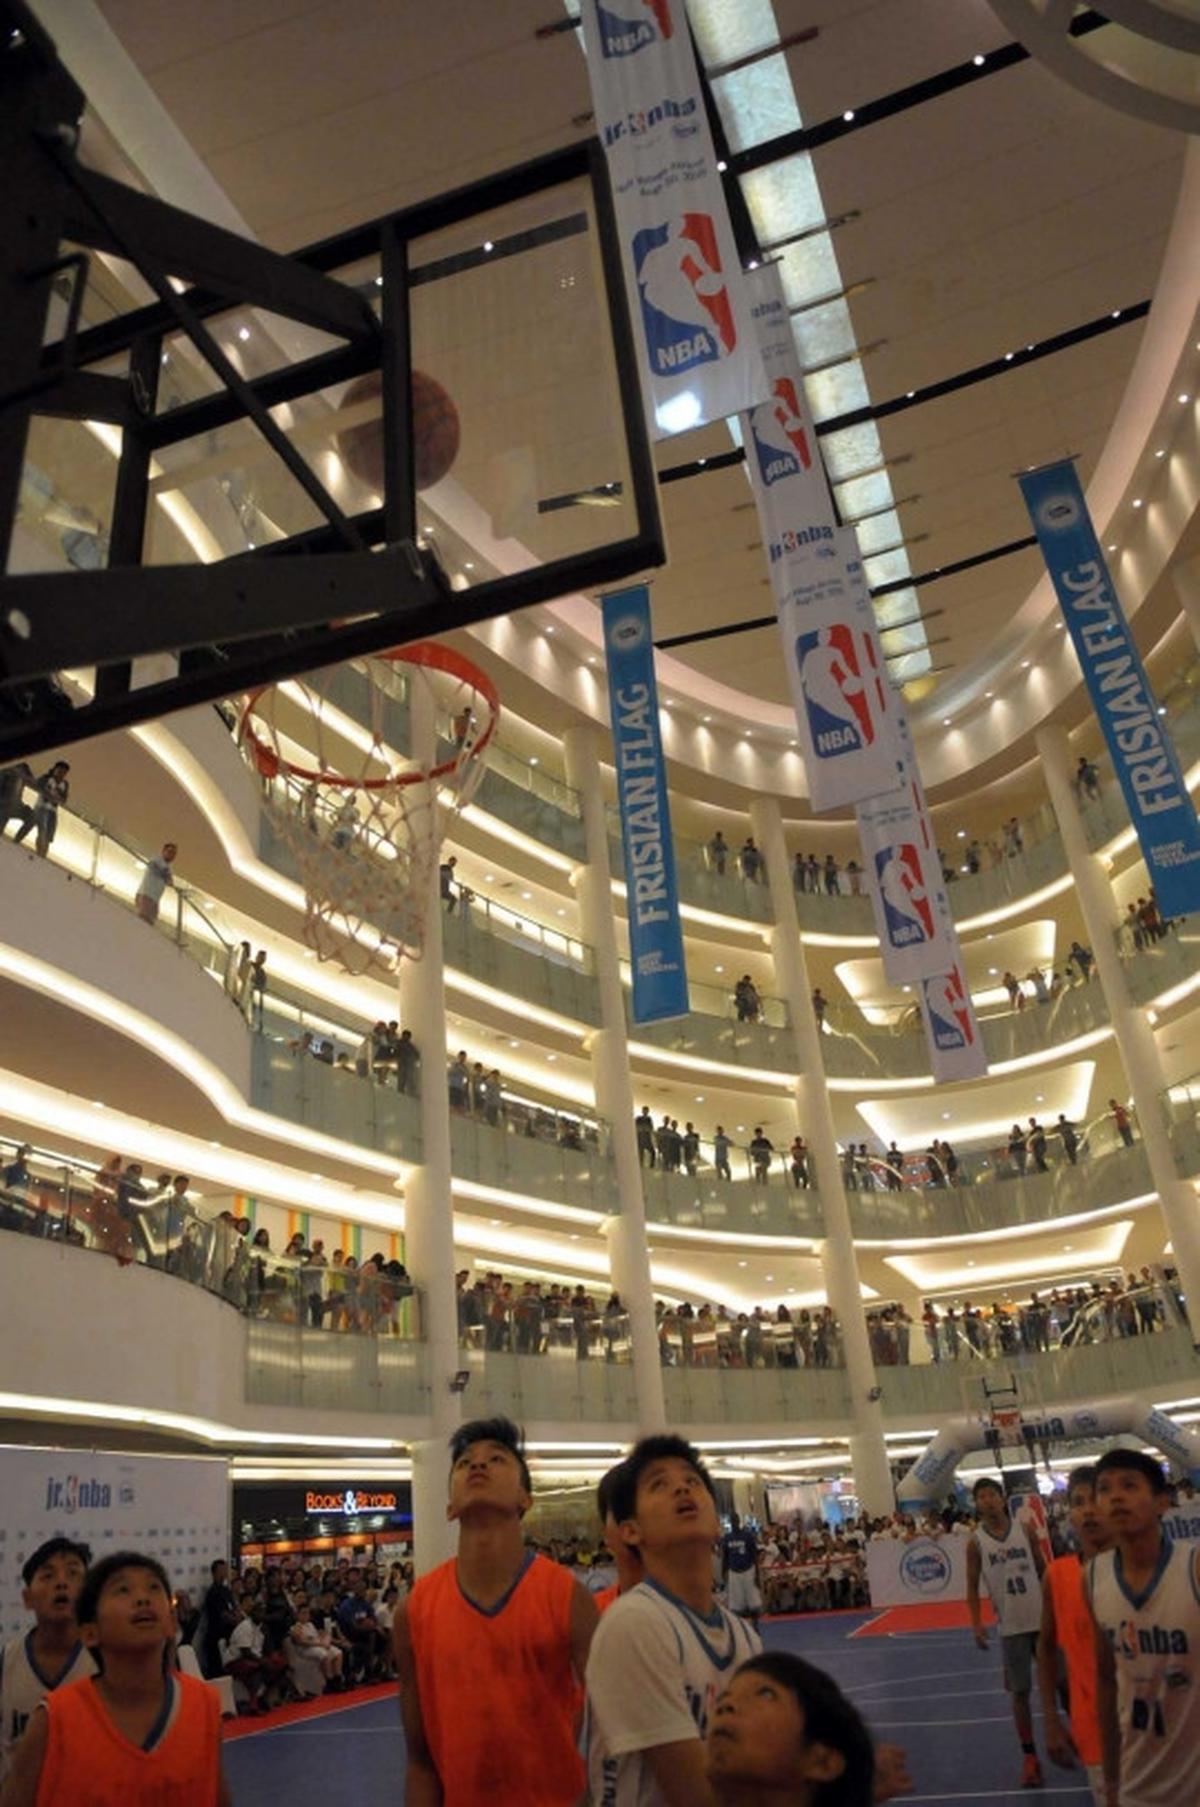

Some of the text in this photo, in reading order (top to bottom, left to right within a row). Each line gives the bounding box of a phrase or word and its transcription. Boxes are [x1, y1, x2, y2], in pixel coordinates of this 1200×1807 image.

[607, 24, 652, 54] NBA
[657, 332, 712, 369] NBA
[1062, 559, 1126, 656] FLAG
[617, 682, 655, 772] FLAG
[817, 726, 857, 752] NBA
[1095, 654, 1183, 817] FRISIAN
[624, 774, 669, 927] FRISIAN
[892, 924, 921, 944] NBA
[344, 1489, 360, 1515] &
[1138, 1624, 1188, 1654] nba
